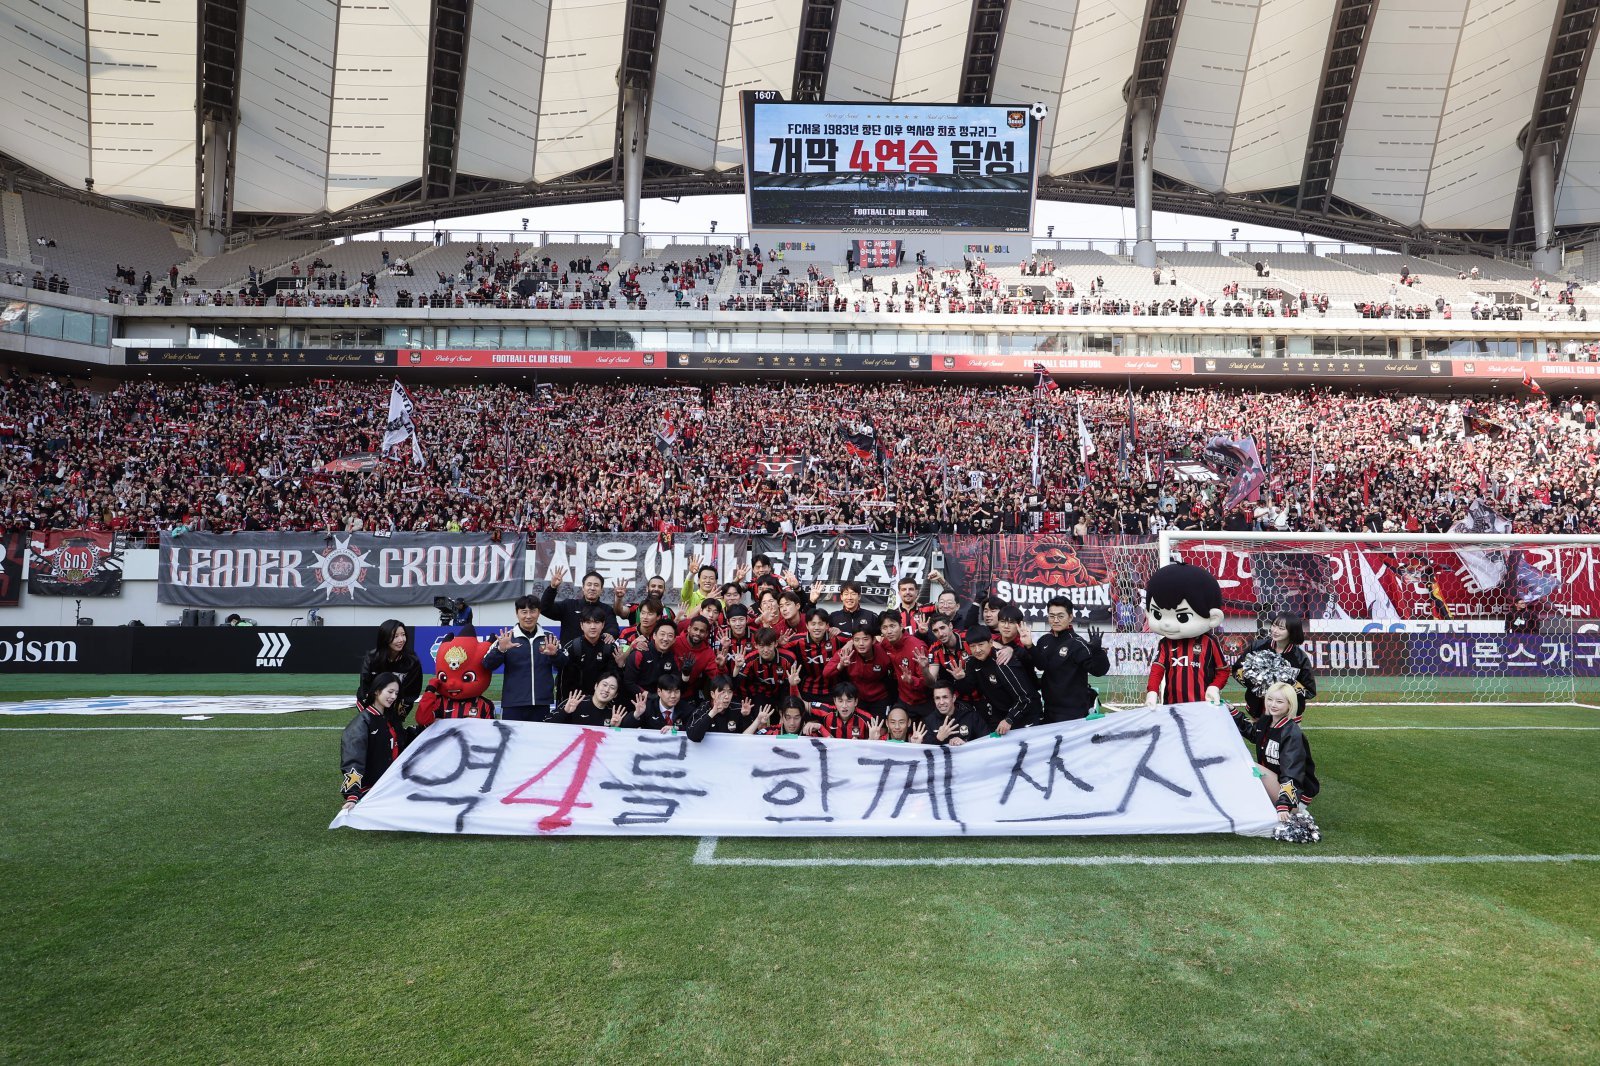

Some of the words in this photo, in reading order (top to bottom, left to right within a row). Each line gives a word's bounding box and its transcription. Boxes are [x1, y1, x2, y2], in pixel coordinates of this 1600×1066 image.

[754, 91, 776, 100] 16:07
[788, 124, 821, 135] FC서울
[823, 125, 859, 136] 1983년
[862, 125, 882, 136] 창단
[884, 125, 904, 137] 이후
[906, 125, 935, 137] 역사상
[937, 126, 957, 137] 최초
[959, 126, 997, 138] 정규리그
[769, 138, 839, 174] 개막
[849, 139, 938, 173] 4연승
[950, 141, 1015, 175] 달성
[888, 209, 906, 217] CLUB
[907, 209, 929, 217] SEOUL
[866, 227, 891, 235] WORLD
[492, 355, 527, 363] FOOTBALL
[529, 355, 548, 363] CLUB
[550, 355, 573, 363] SEOUL
[1059, 360, 1078, 368] CLUB
[1080, 360, 1103, 369] SEOUL
[1542, 365, 1576, 374] FOOTBALL
[1577, 366, 1596, 374] CLUB
[168, 547, 304, 588] LEADER
[378, 543, 516, 588] CROWN
[996, 580, 1111, 606] SUHOSHIN
[1115, 642, 1155, 667] play
[1439, 642, 1600, 668] 에몬스가구
[256, 658, 284, 667] PLAY
